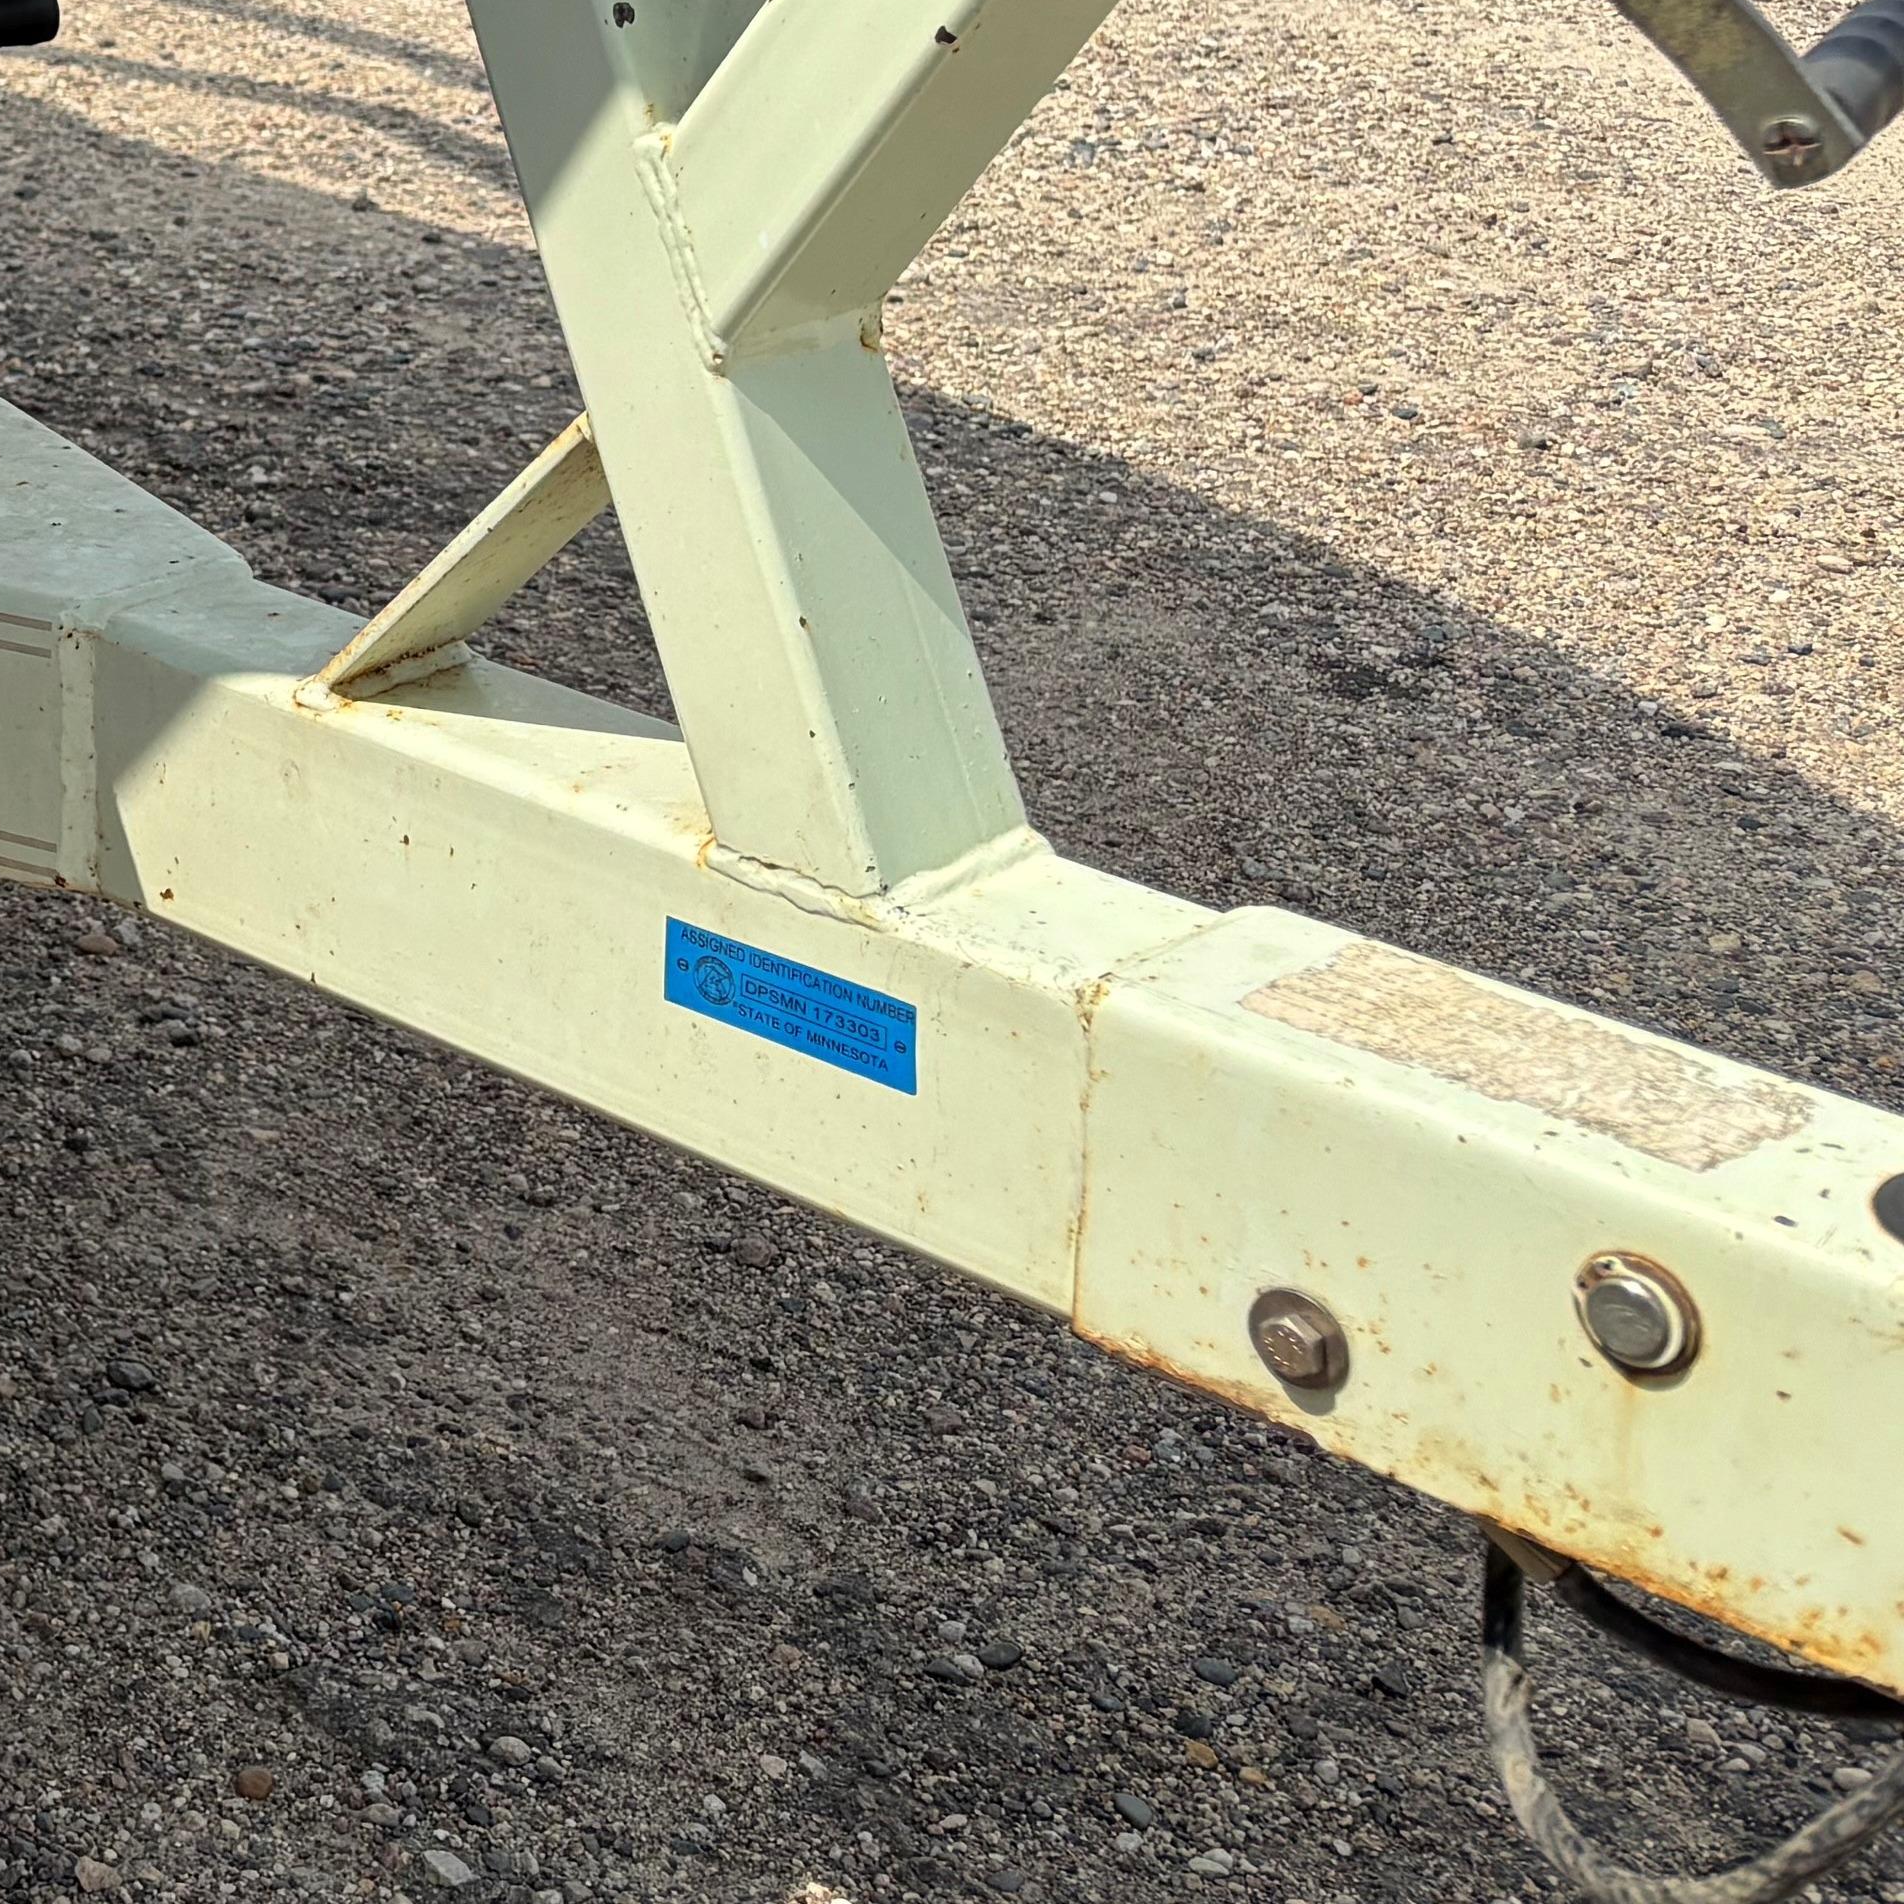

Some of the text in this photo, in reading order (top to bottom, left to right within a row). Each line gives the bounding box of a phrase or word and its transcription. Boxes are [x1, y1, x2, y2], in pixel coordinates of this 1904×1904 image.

[681, 927, 745, 962] ASSIGNED
[749, 953, 853, 1003] IDENTIFICATION
[857, 994, 915, 1024] NUMBER
[738, 1003, 888, 1072] STATE OF MINNESOTA
[745, 981, 880, 1042] DPSMN 173303
